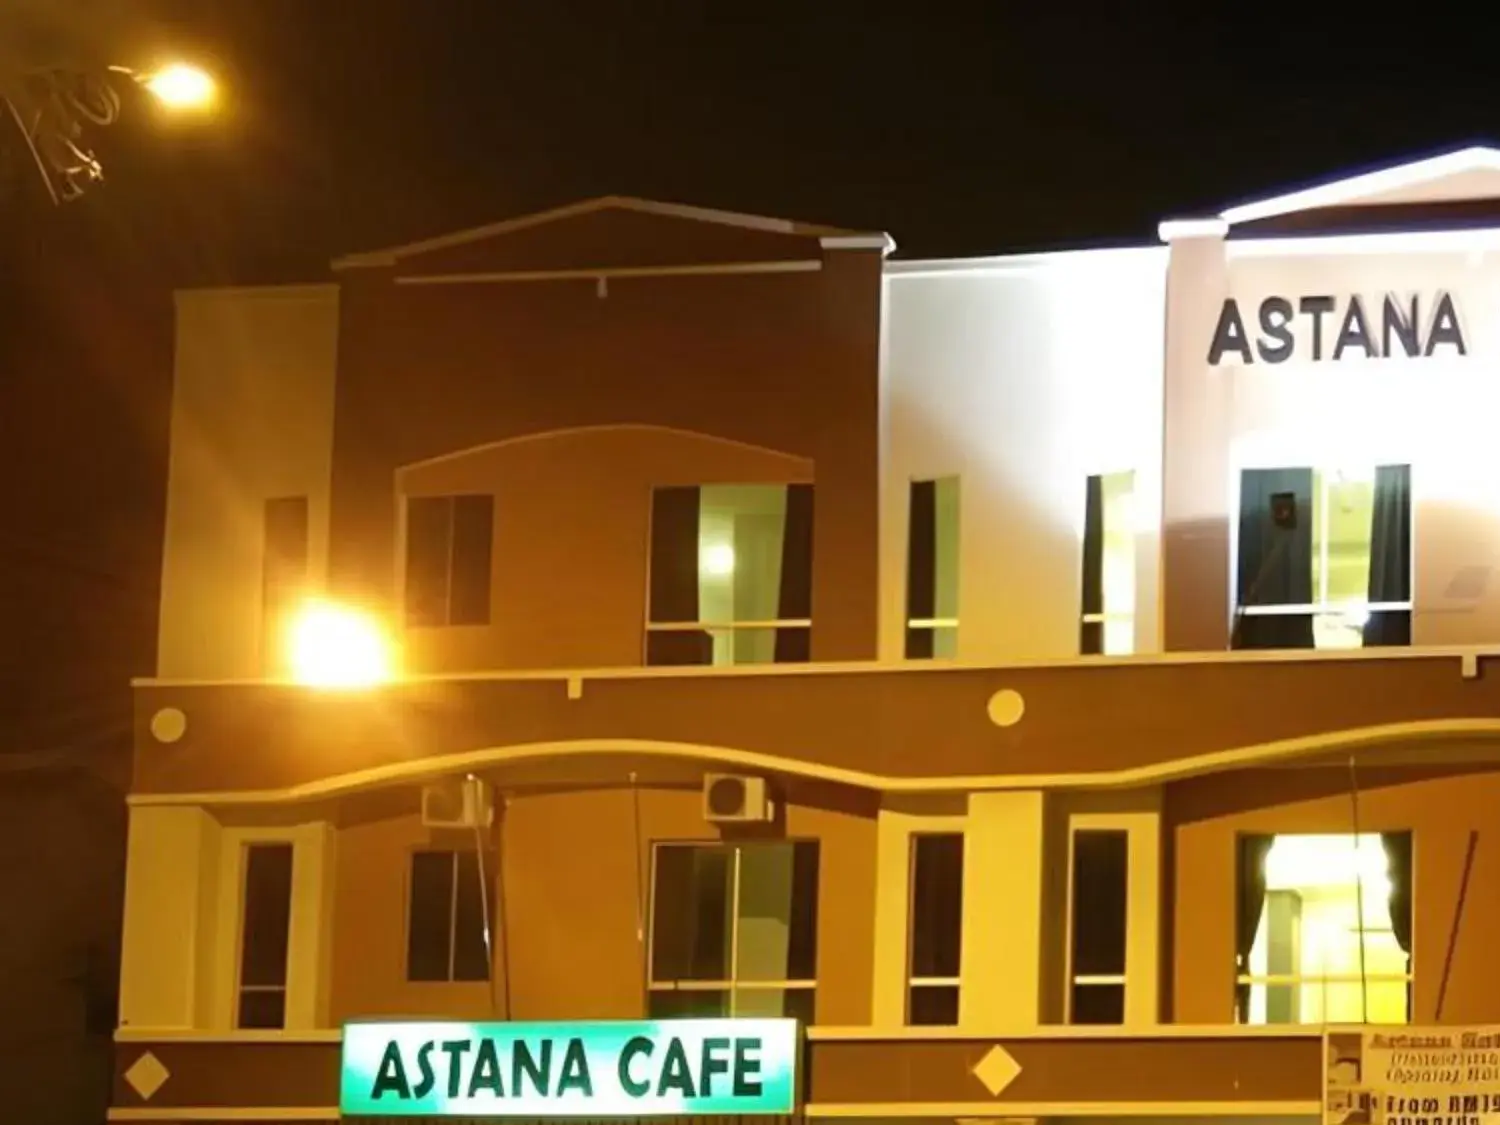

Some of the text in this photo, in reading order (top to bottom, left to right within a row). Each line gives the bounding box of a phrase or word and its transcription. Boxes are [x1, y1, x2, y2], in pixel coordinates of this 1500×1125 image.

[1206, 291, 1467, 365] ASTANA
[370, 1035, 763, 1100] ASTANA CAFE
